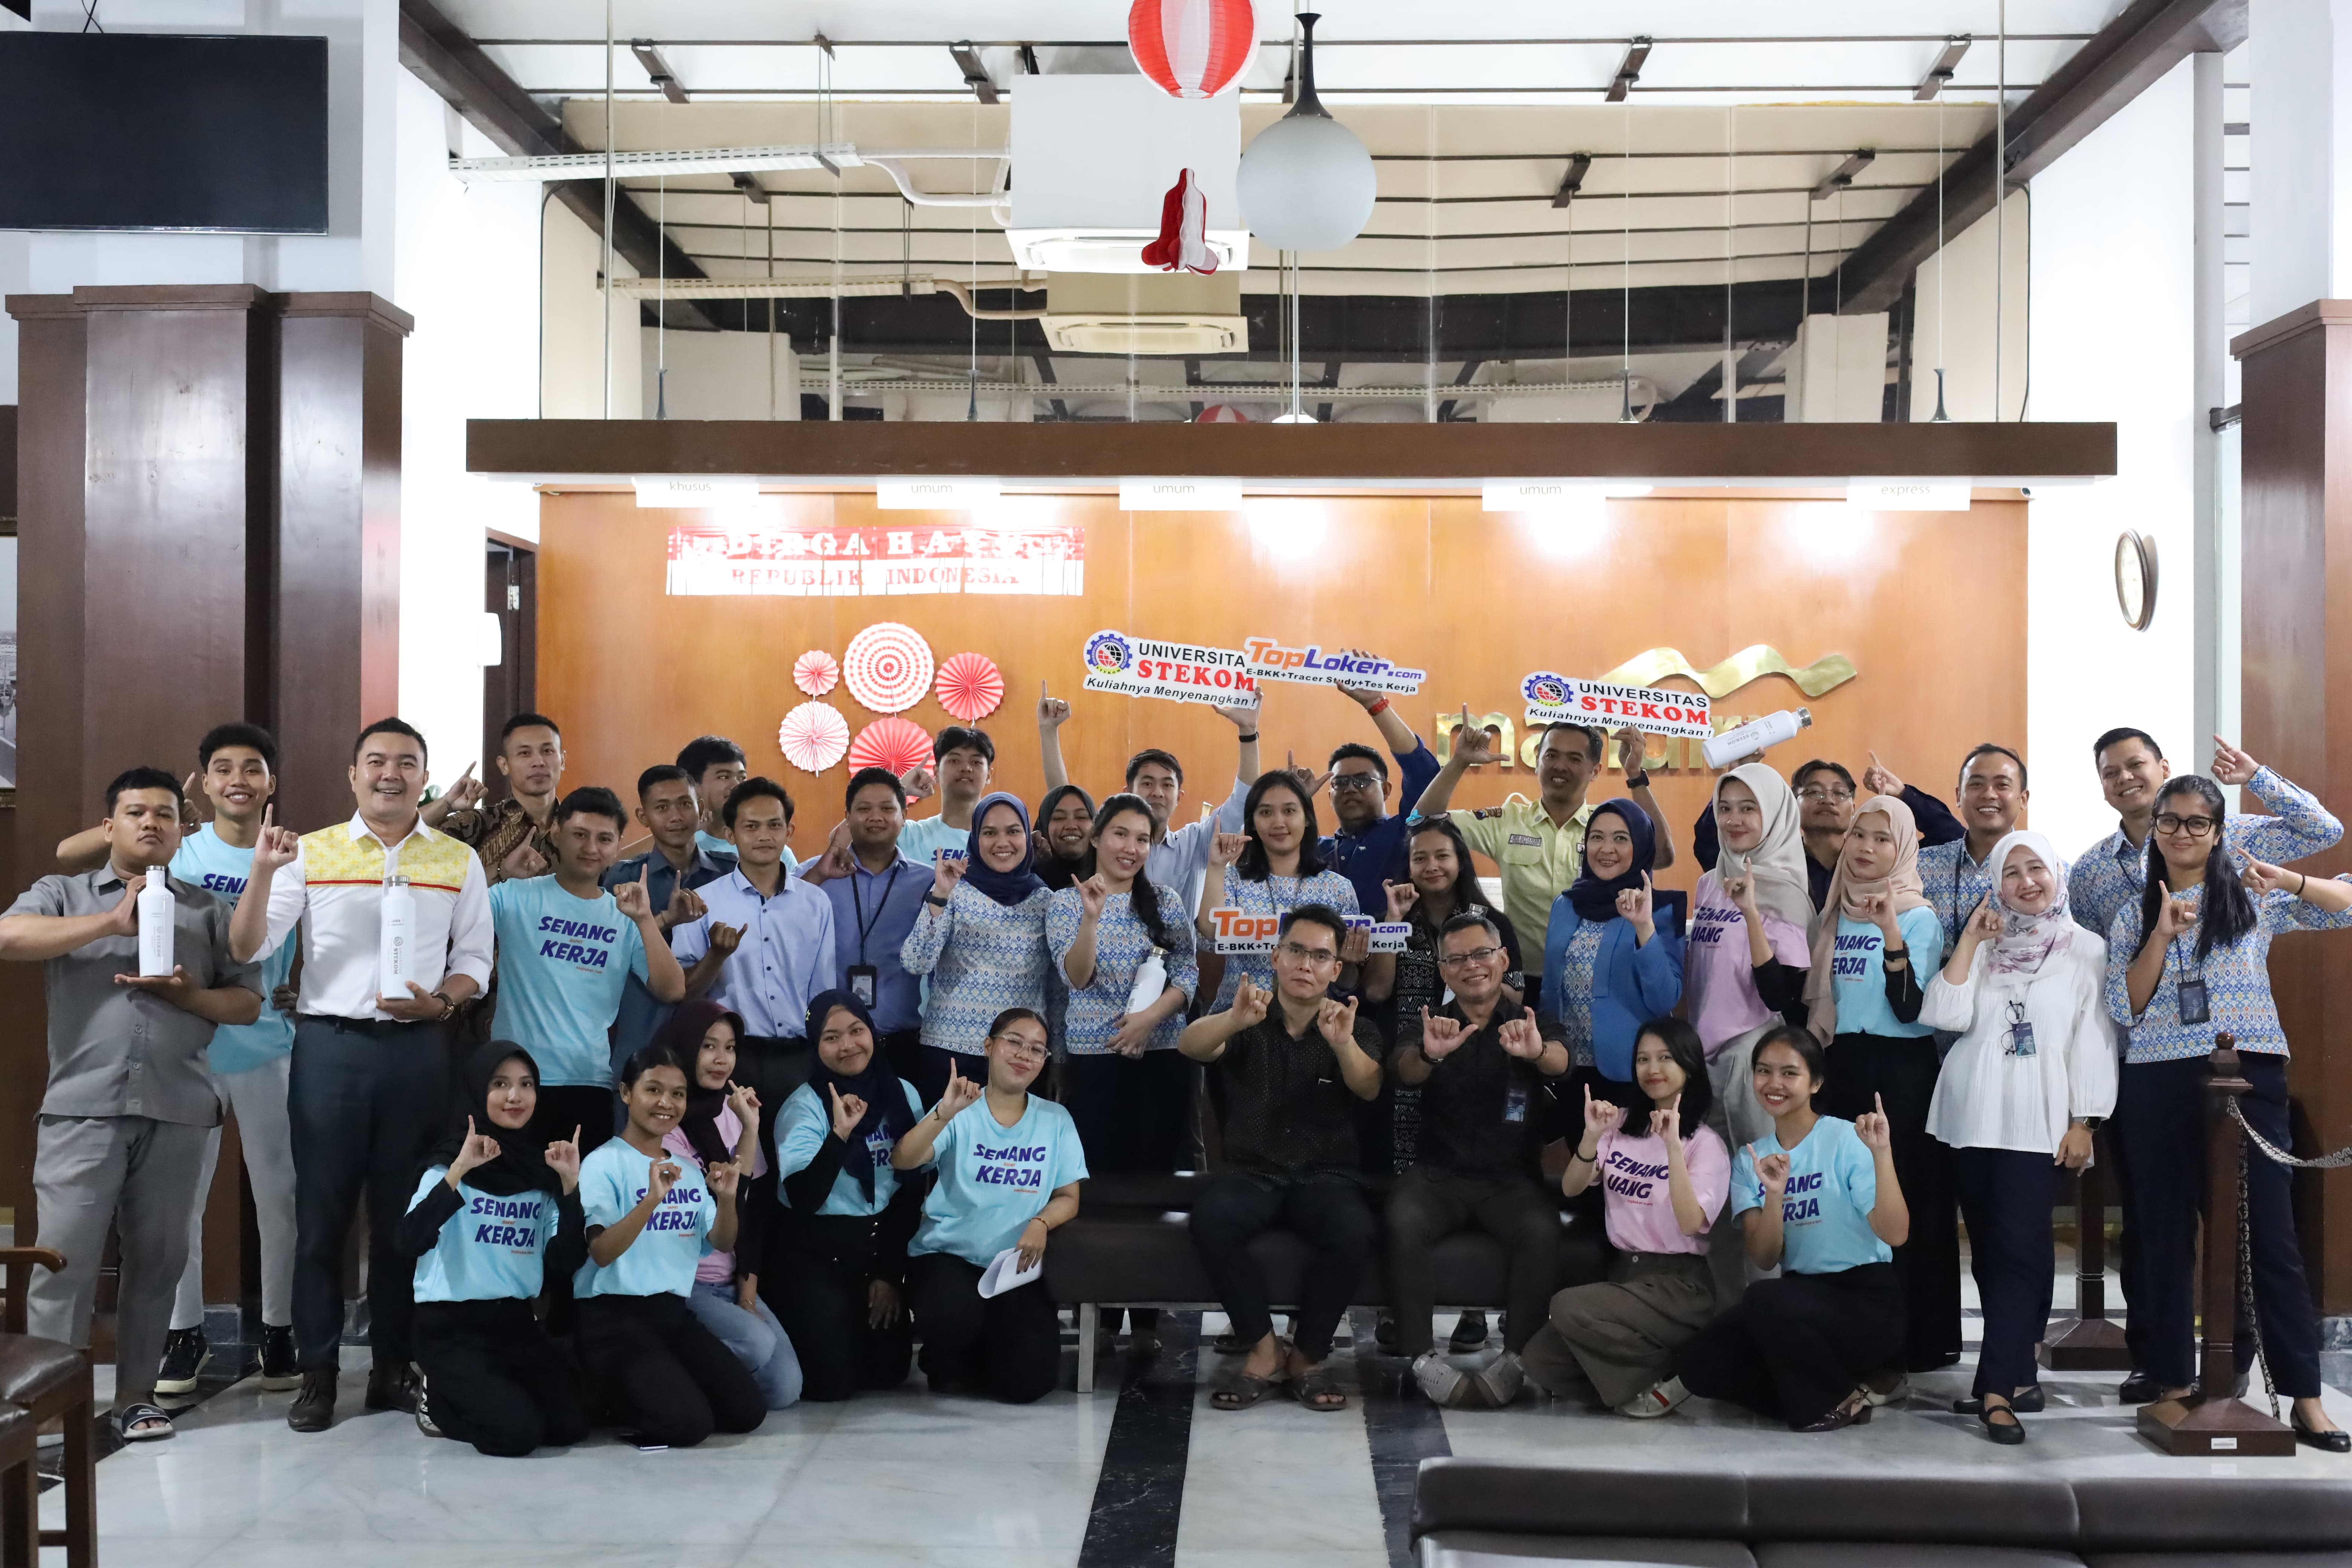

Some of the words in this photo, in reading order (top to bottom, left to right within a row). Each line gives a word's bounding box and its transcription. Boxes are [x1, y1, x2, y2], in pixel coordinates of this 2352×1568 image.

[669, 481, 711, 491] khusus
[911, 485, 952, 493] umum
[1153, 485, 1195, 494] umum
[1520, 486, 1561, 495] umum
[1881, 485, 1930, 497] express
[731, 568, 864, 585] REPUBLIK
[886, 567, 1020, 585] INDONESIA
[1139, 643, 1245, 668] UNIVERSITA
[1249, 641, 1422, 680] TopLoker.com
[1096, 666, 1121, 674] STEKOM
[1138, 660, 1255, 691] STEKOM
[1246, 668, 1323, 682] E-BKK+Tracer
[1386, 683, 1416, 692] Kerja
[1087, 678, 1150, 694] Kuliahnya
[1154, 686, 1248, 706] Menyenangkan
[1580, 683, 1707, 707] UNIVERSITAS
[1529, 709, 1597, 723] Kuliahnya
[1581, 696, 1708, 725] STEKOM
[931, 849, 966, 861] SEN
[201, 874, 248, 894] SEN
[538, 916, 617, 943] SENANG
[1213, 911, 1407, 940] Topr.com
[1692, 927, 1724, 943] UANG
[1372, 941, 1404, 949] Kerja
[1835, 935, 1882, 951] NANG
[540, 940, 608, 968] KERJA
[1833, 957, 1867, 975] ERJA
[974, 1144, 1046, 1162] SENANG
[1606, 1151, 1669, 1180] SENANG
[975, 1165, 1041, 1187] KERJA
[1758, 1173, 1822, 1198] SANG
[636, 1188, 701, 1204] SANG
[1608, 1174, 1653, 1199] UANG
[470, 1197, 541, 1220] SENANG
[1782, 1198, 1820, 1222] RJA
[646, 1211, 698, 1231] KERJA
[475, 1224, 536, 1247] KERJA
